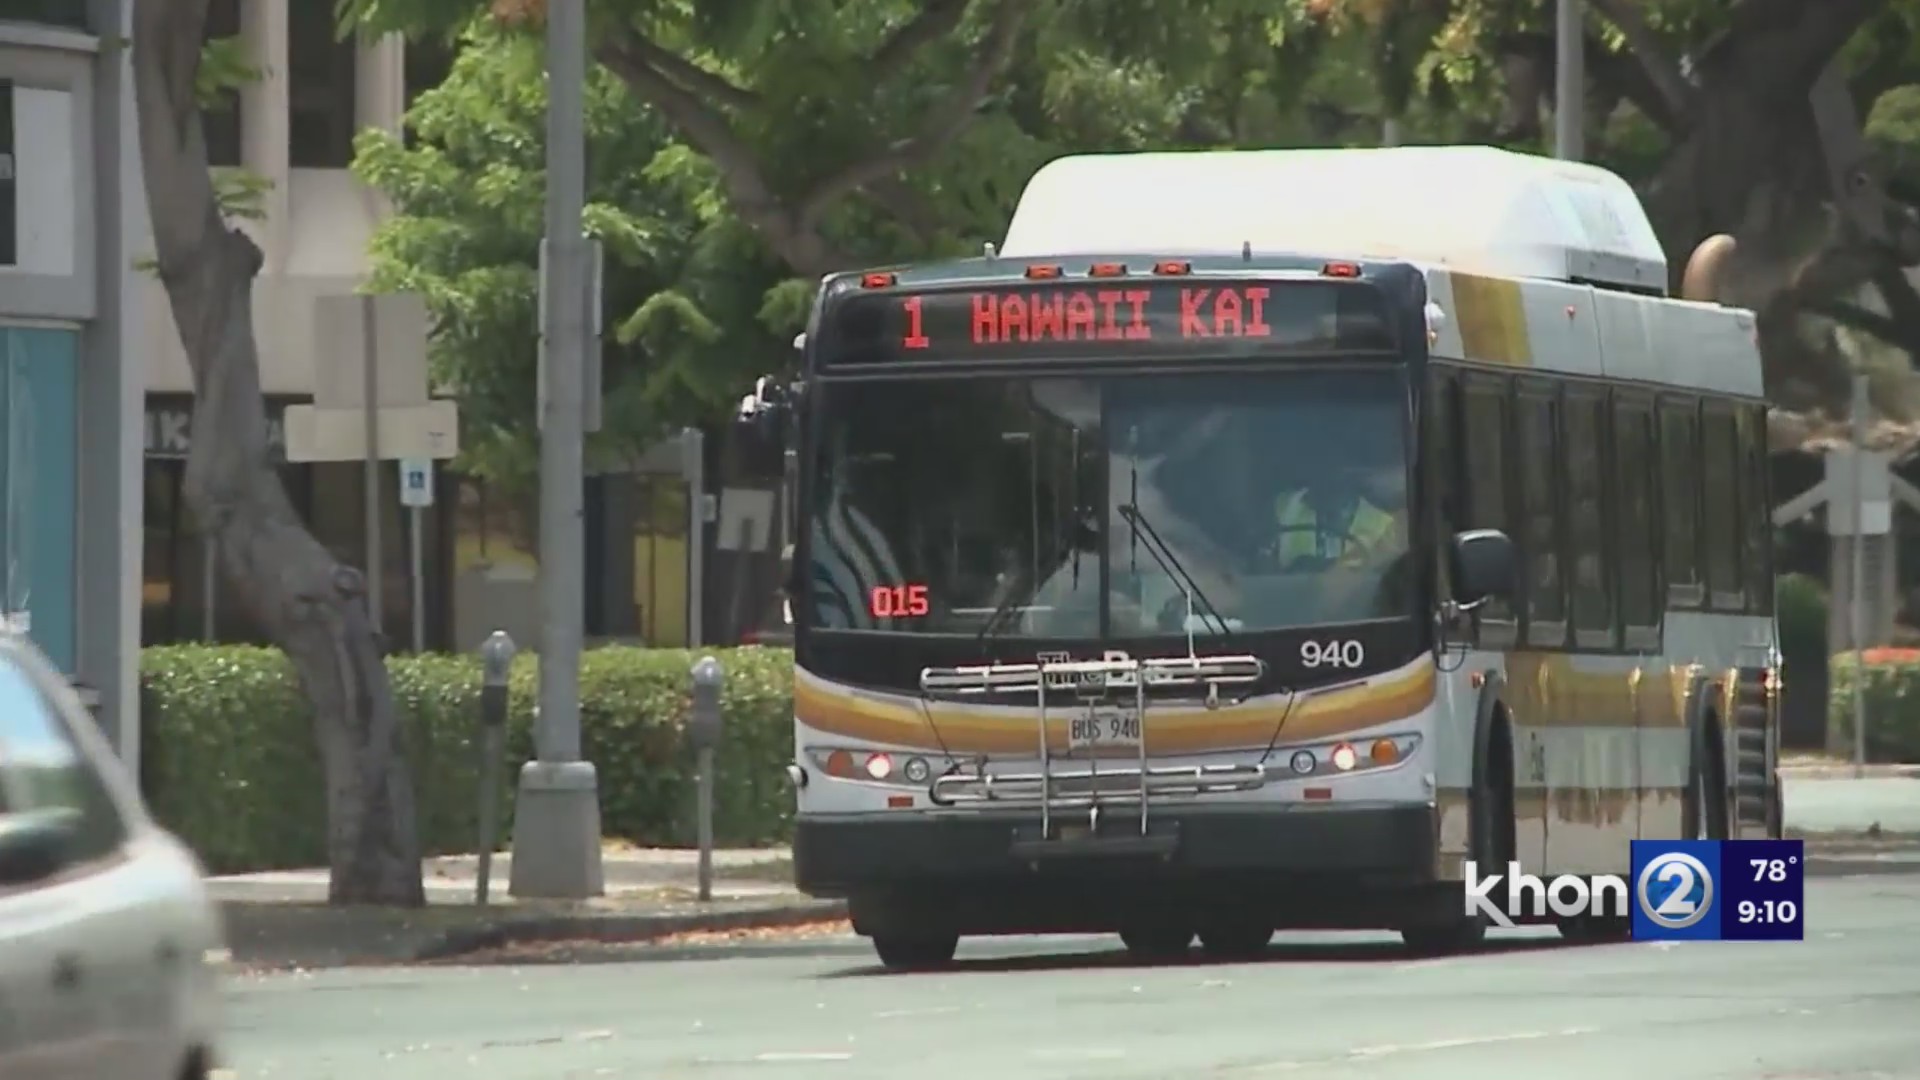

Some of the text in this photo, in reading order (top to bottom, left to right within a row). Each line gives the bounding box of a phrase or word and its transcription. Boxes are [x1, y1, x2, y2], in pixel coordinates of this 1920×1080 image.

[904, 287, 1270, 348] 1 HAWAII KAI
[872, 585, 929, 616] 015
[1300, 640, 1364, 668] 940
[1071, 718, 1140, 740] BUS 940
